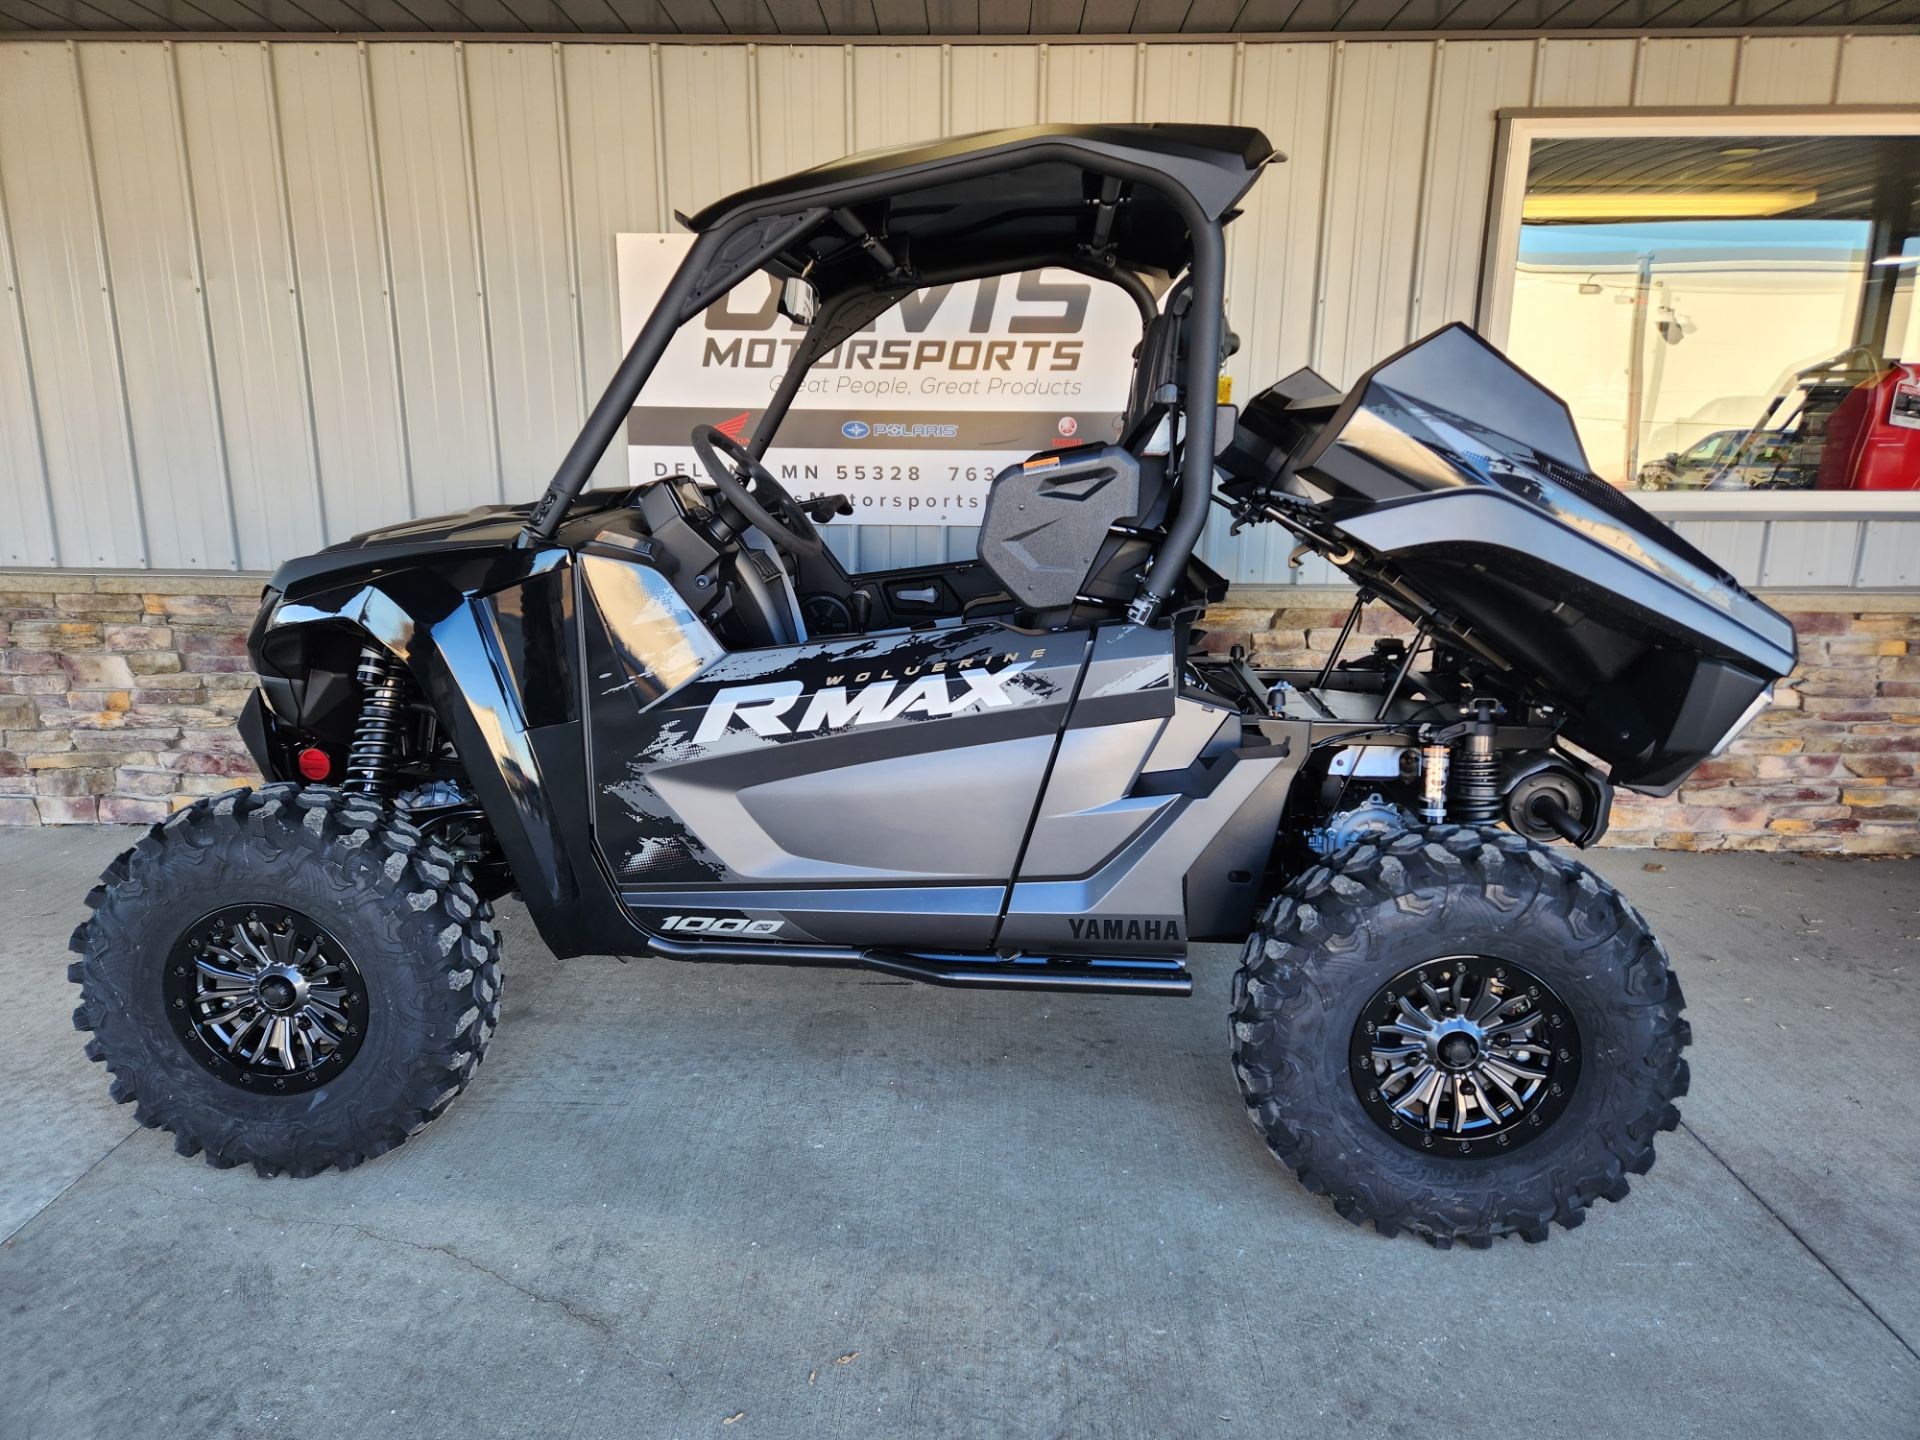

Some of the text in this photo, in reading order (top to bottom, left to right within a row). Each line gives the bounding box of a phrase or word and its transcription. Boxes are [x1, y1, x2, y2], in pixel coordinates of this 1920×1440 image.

[704, 266, 1091, 334] DVIS
[770, 374, 1082, 398] Geat People, Great Products
[873, 424, 958, 438] POLARIS
[781, 464, 819, 480] MN
[836, 465, 920, 481] 55328
[692, 660, 1037, 744] RMAX
[1068, 918, 1180, 941] YAMAHA
